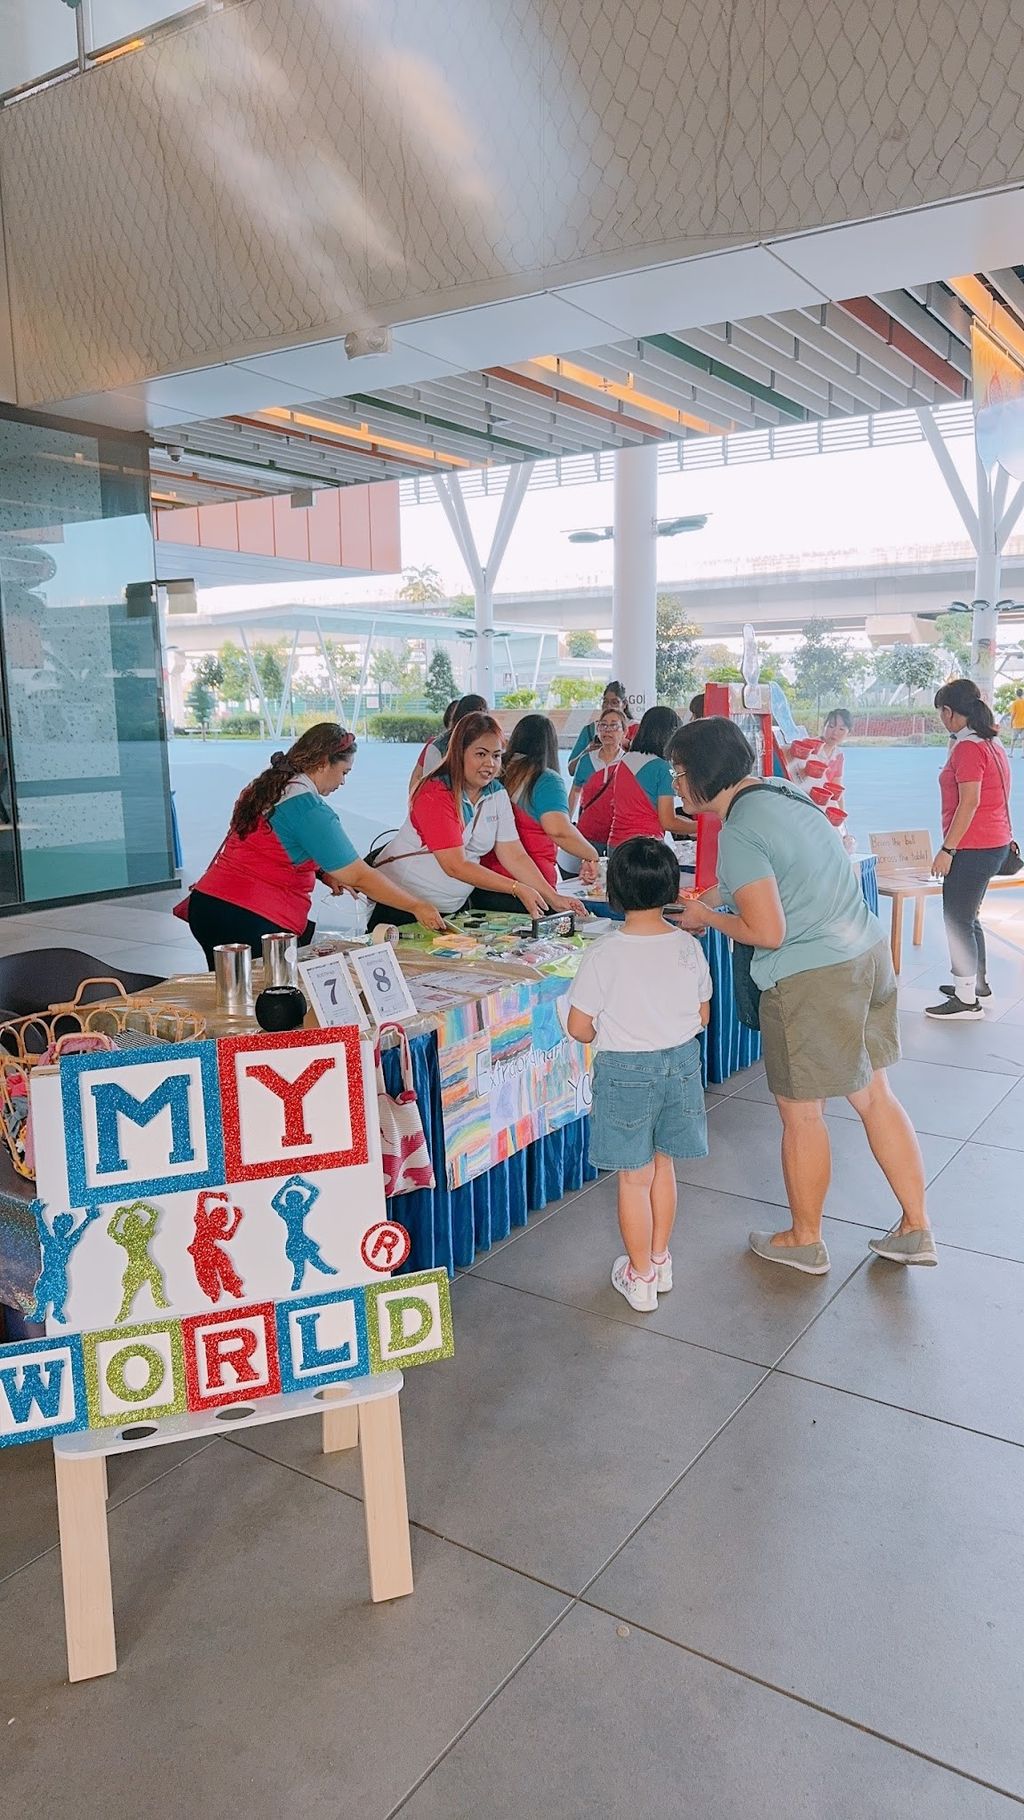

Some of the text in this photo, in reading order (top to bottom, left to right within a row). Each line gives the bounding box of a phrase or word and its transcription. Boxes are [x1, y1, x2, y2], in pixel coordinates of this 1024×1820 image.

[323, 978, 338, 1006] 7
[372, 967, 392, 993] 8
[90, 1057, 336, 1175] MY
[0, 1297, 434, 1424] WORLD
